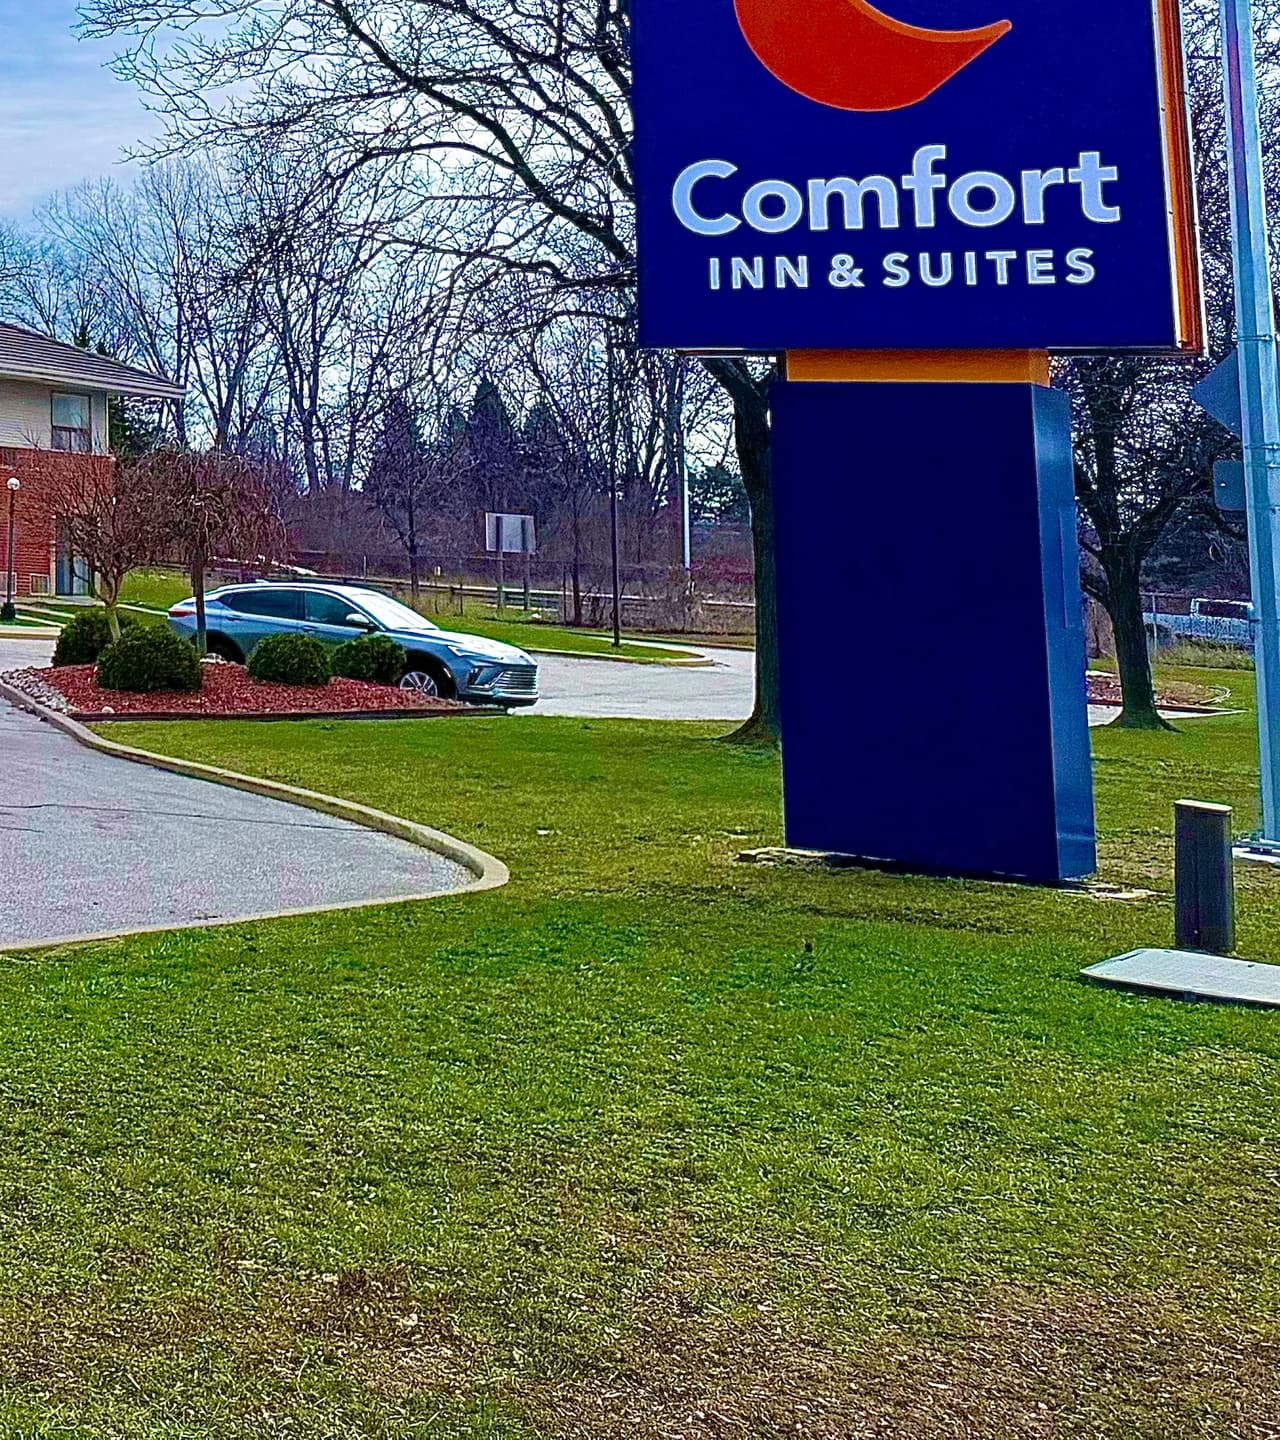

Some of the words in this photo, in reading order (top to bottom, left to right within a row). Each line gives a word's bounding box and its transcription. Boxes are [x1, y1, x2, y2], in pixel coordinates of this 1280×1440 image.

[671, 144, 1121, 236] Comfort
[708, 254, 810, 290] INN
[827, 252, 867, 288] &
[882, 247, 1097, 288] SUITES
